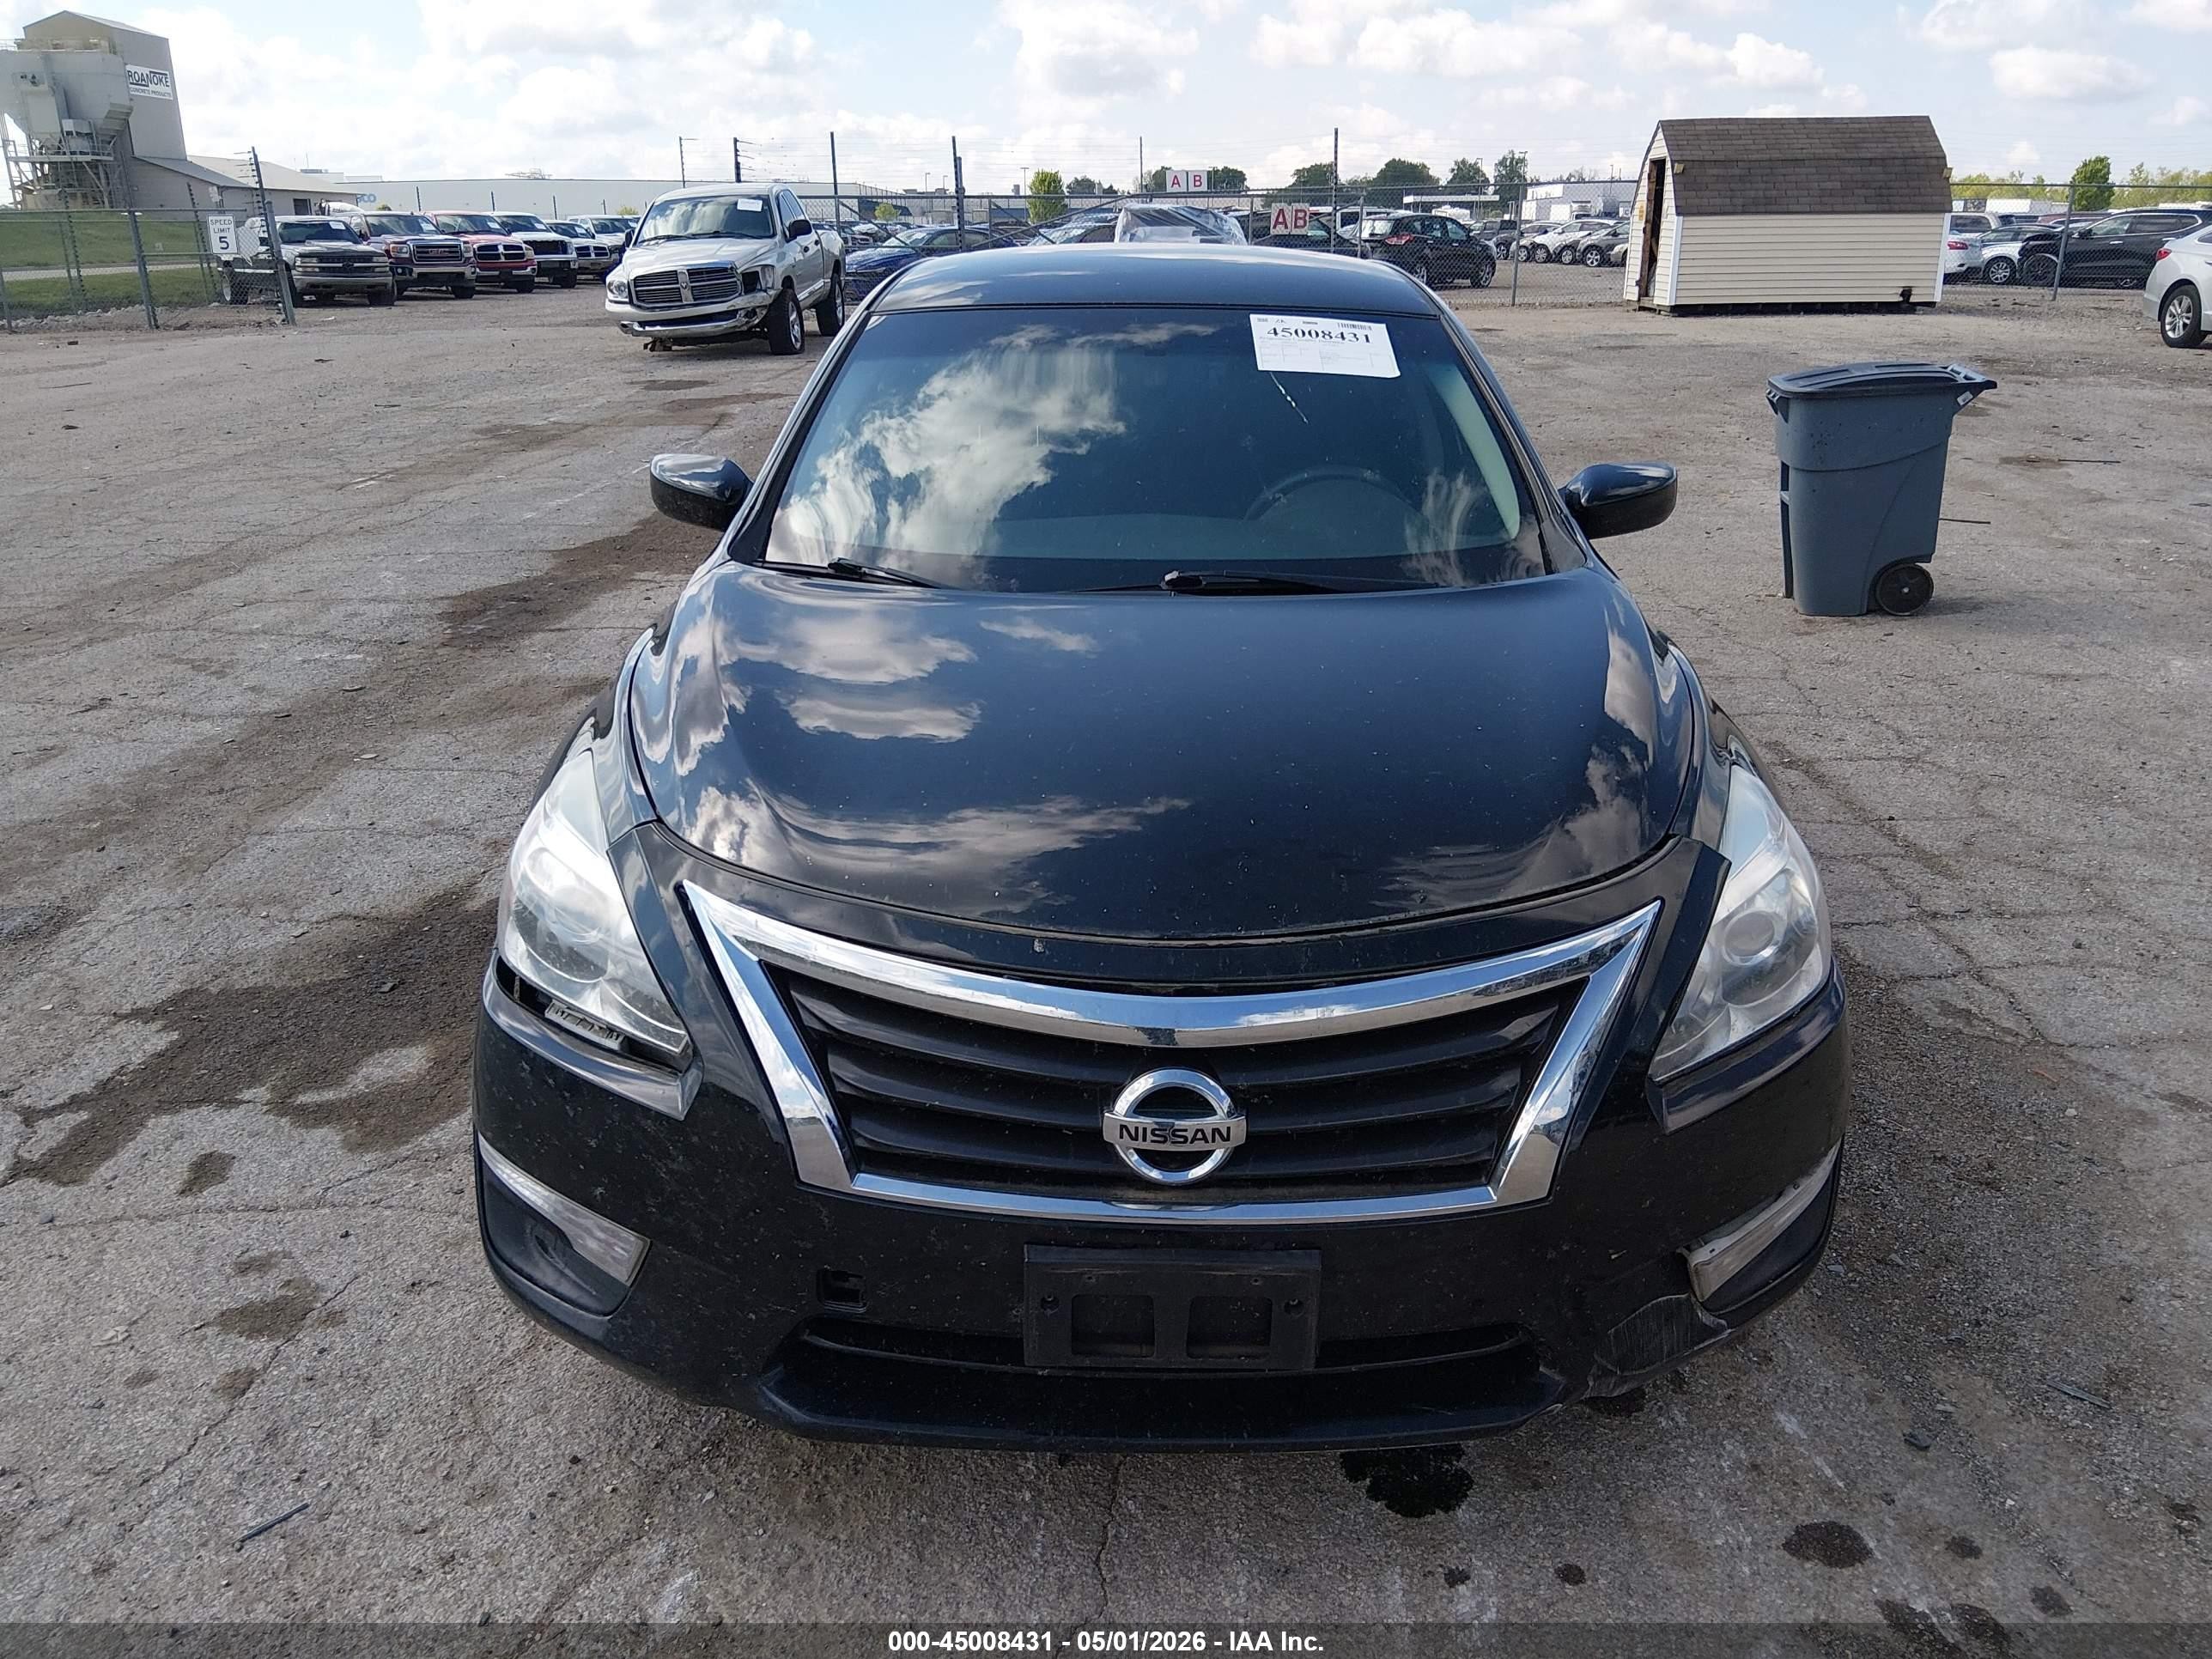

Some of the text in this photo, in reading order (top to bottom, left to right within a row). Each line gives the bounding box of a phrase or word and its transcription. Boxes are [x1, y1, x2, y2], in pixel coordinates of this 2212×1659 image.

[127, 70, 170, 88] ROANOKE
[1170, 174, 1203, 188] A B
[1272, 208, 1308, 230] A B
[219, 236, 229, 250] 5
[1267, 326, 1371, 343] 45008431
[1119, 1123, 1231, 1145] NISSAN
